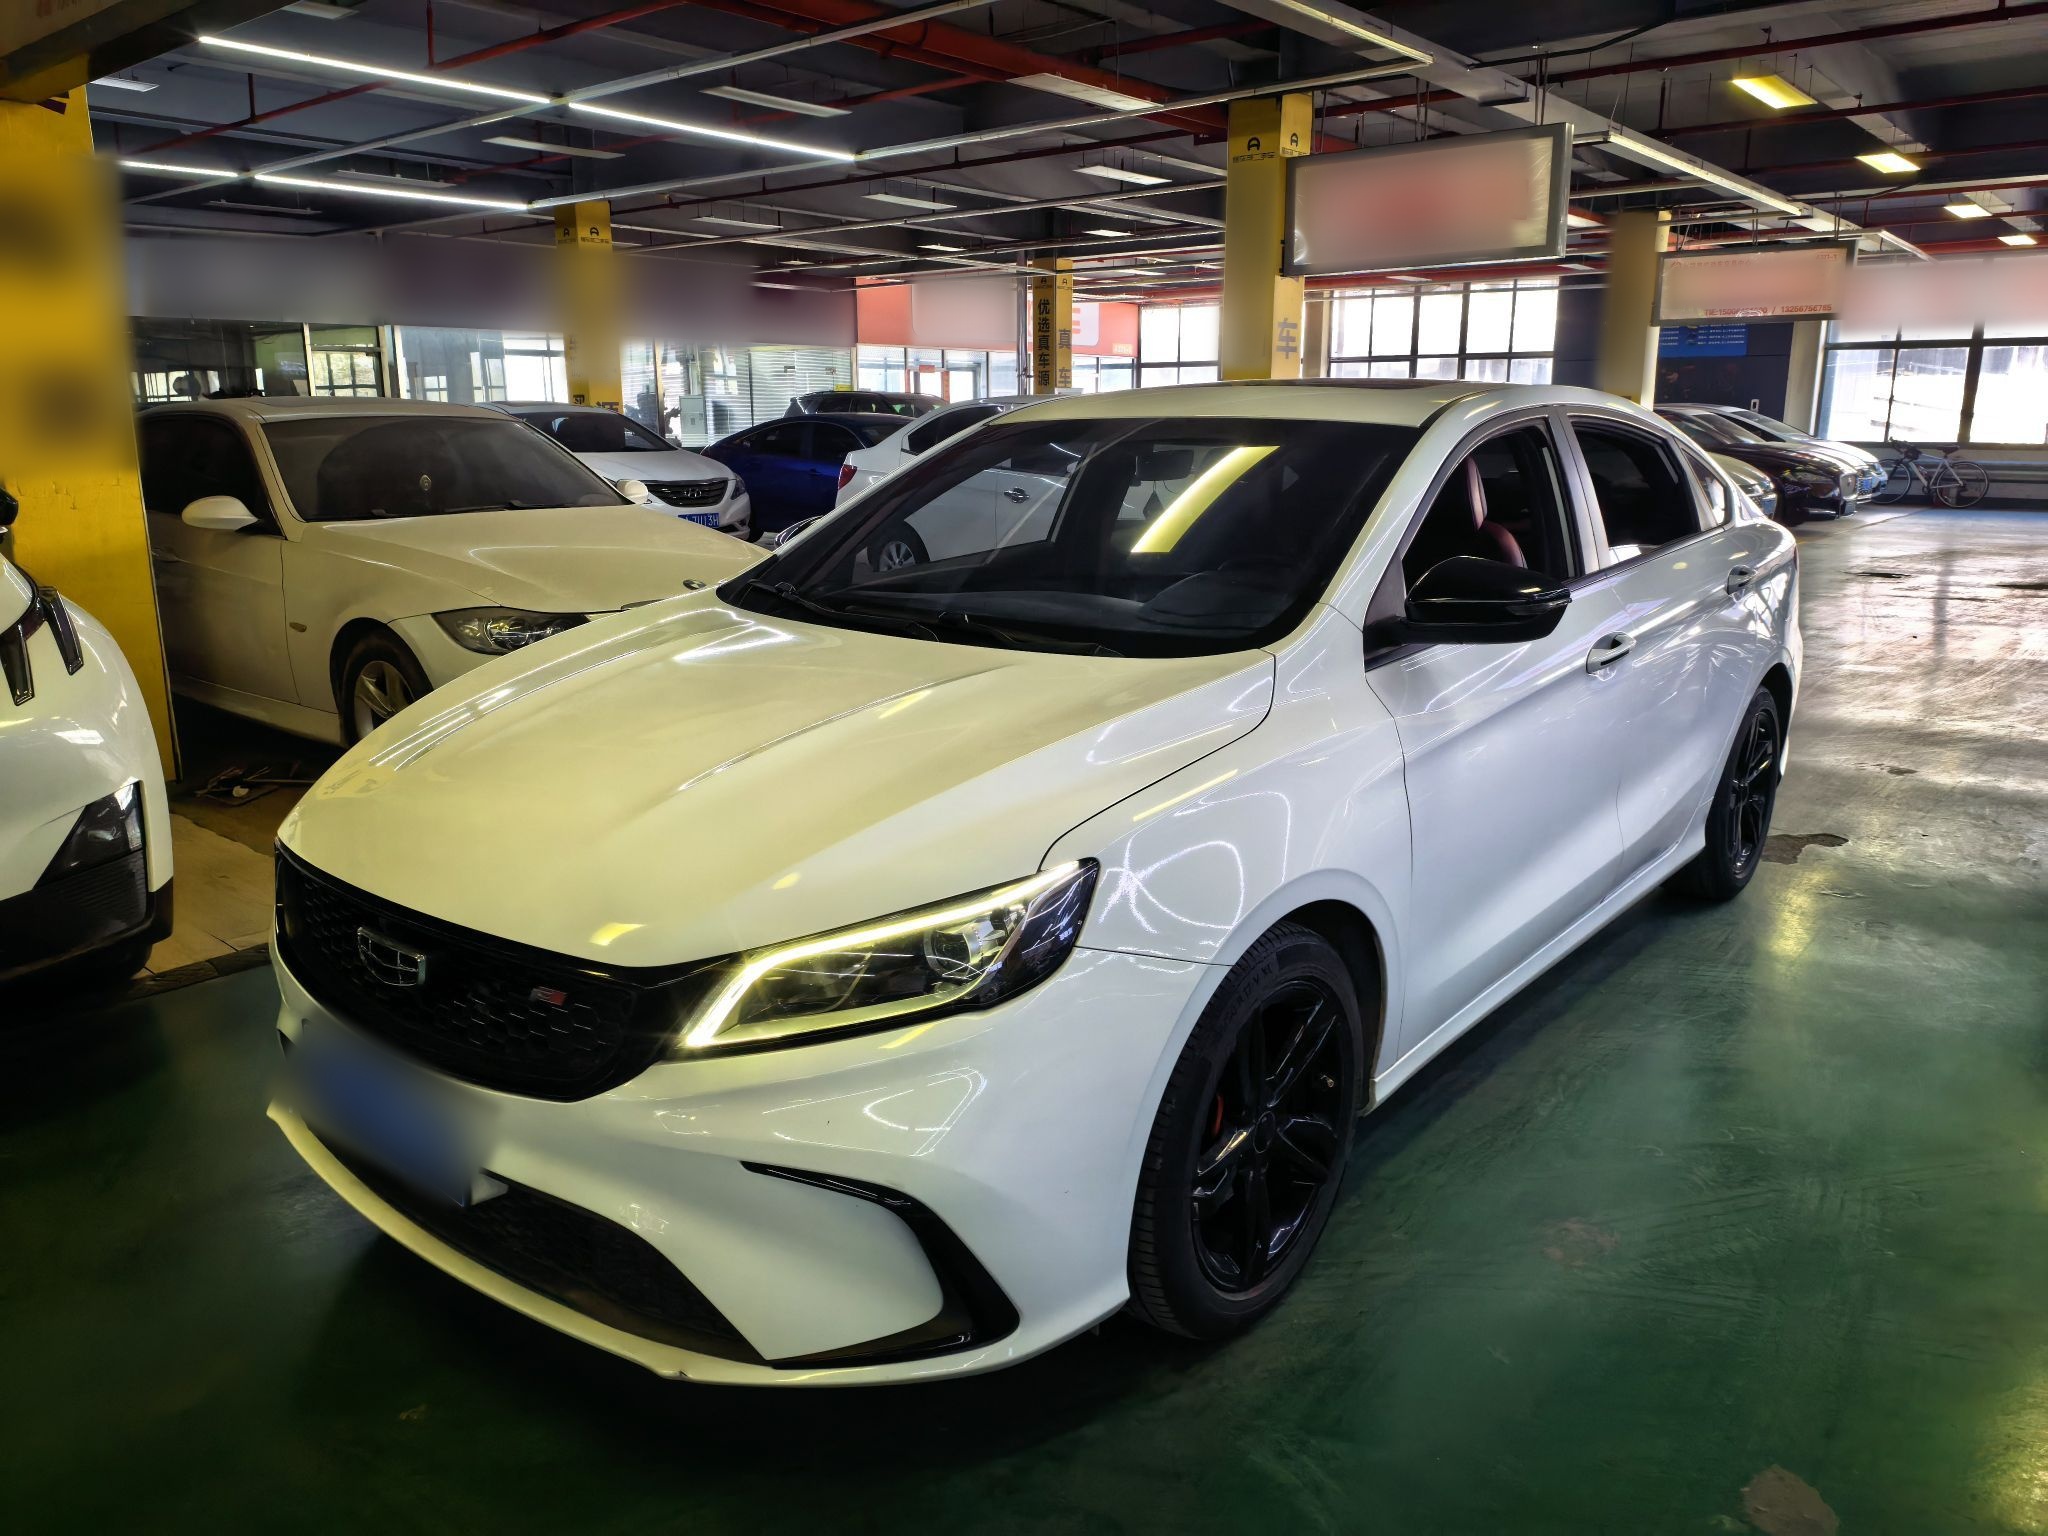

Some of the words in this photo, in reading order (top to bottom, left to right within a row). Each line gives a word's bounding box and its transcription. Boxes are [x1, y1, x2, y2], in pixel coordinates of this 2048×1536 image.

[1038, 298, 1050, 386] 优选真车源
